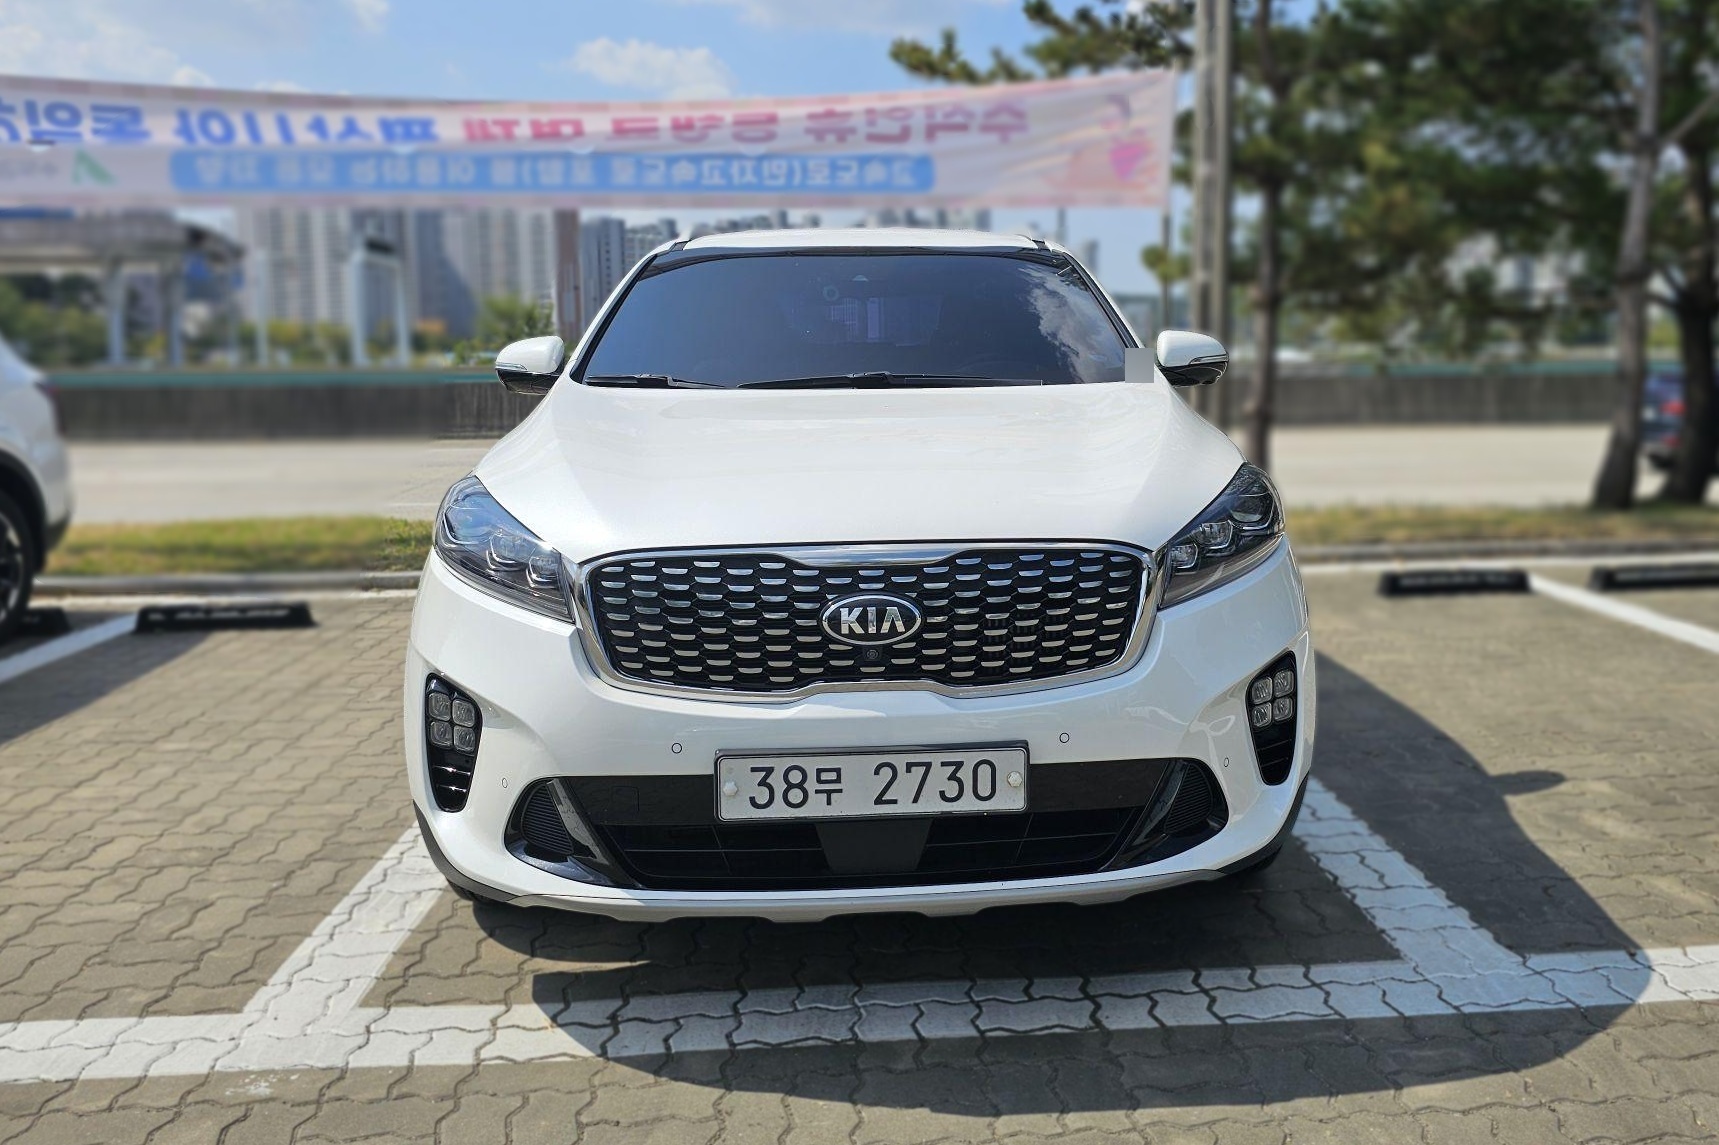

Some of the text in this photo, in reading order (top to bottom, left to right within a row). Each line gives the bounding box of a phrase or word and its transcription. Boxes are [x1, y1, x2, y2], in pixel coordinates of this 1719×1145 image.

[840, 606, 905, 634] KIA
[749, 759, 997, 809] 38무 2730
